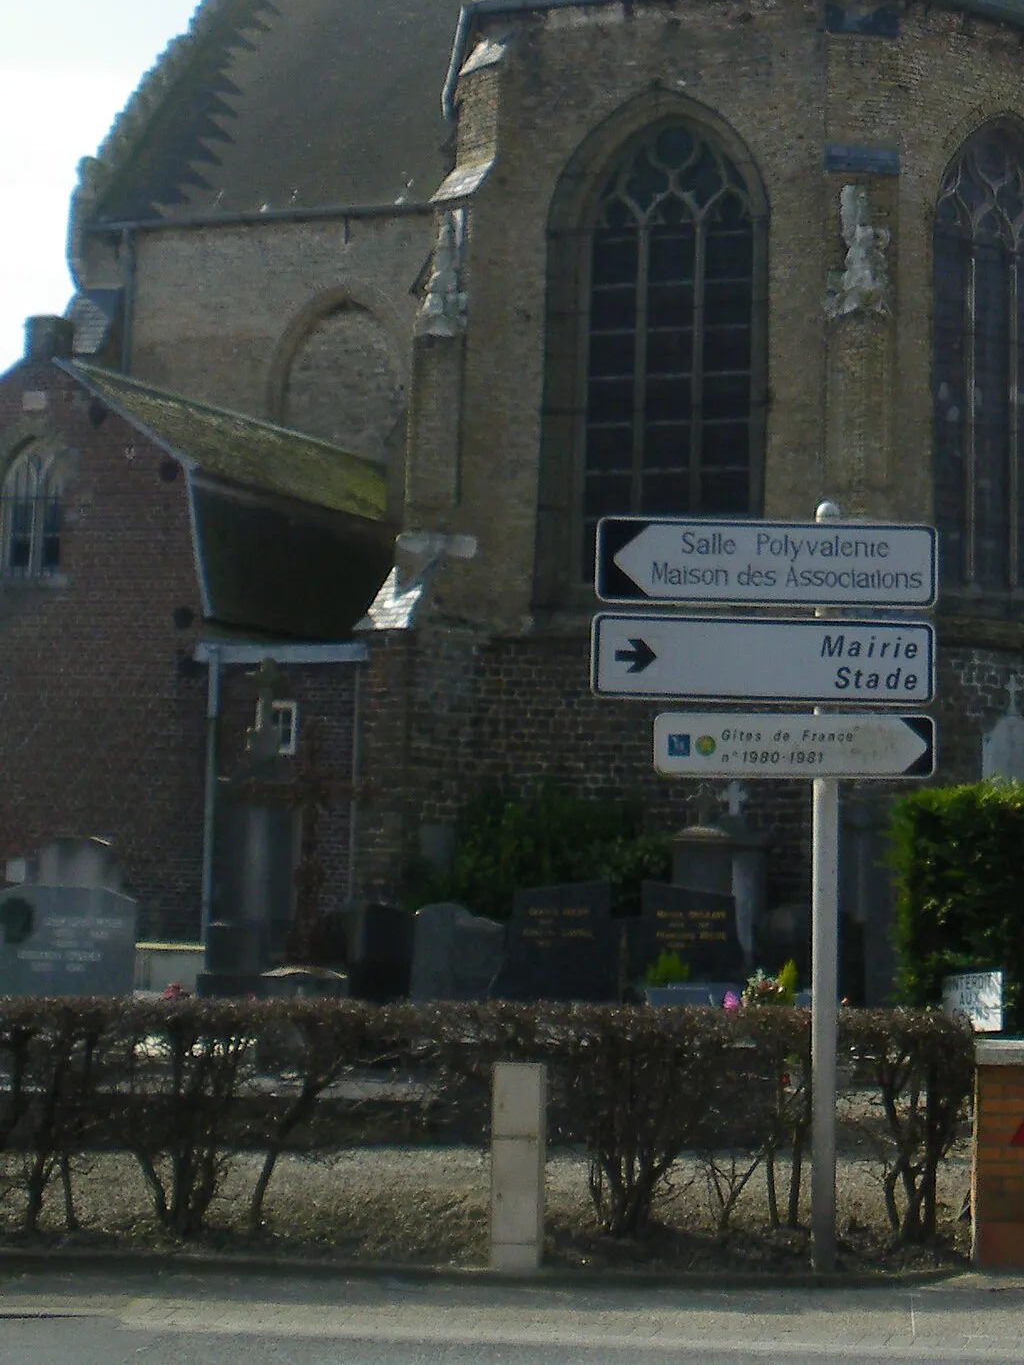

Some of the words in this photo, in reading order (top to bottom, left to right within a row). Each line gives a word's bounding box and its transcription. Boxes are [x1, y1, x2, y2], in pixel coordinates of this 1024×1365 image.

[681, 531, 737, 555] Salle
[756, 532, 890, 563] Polyvalente
[651, 561, 728, 587] Maison
[737, 563, 777, 587] des
[784, 566, 923, 590] Associations
[820, 634, 918, 659] Mairie
[834, 666, 918, 691] Stade
[773, 729, 791, 742] de
[801, 729, 855, 743] France
